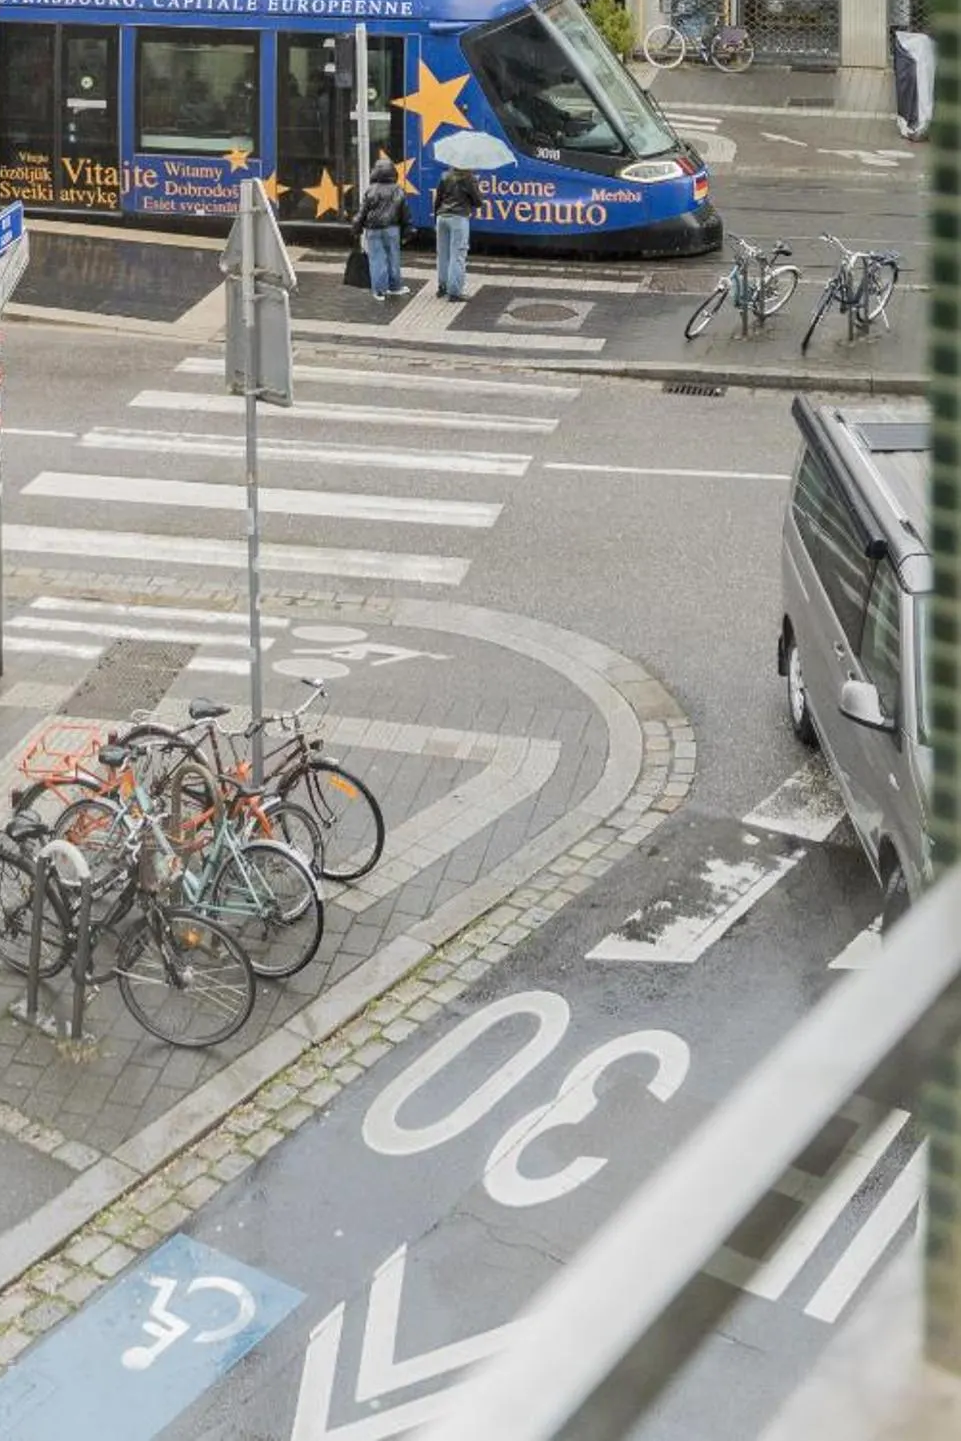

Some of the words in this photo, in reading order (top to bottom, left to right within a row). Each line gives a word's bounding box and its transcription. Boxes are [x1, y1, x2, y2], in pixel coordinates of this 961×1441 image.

[61, 157, 159, 195] Vitajte
[164, 160, 223, 182] Witamy
[0, 180, 54, 201] Sveiki
[476, 174, 557, 198] elcome
[429, 187, 608, 226] nvenuto
